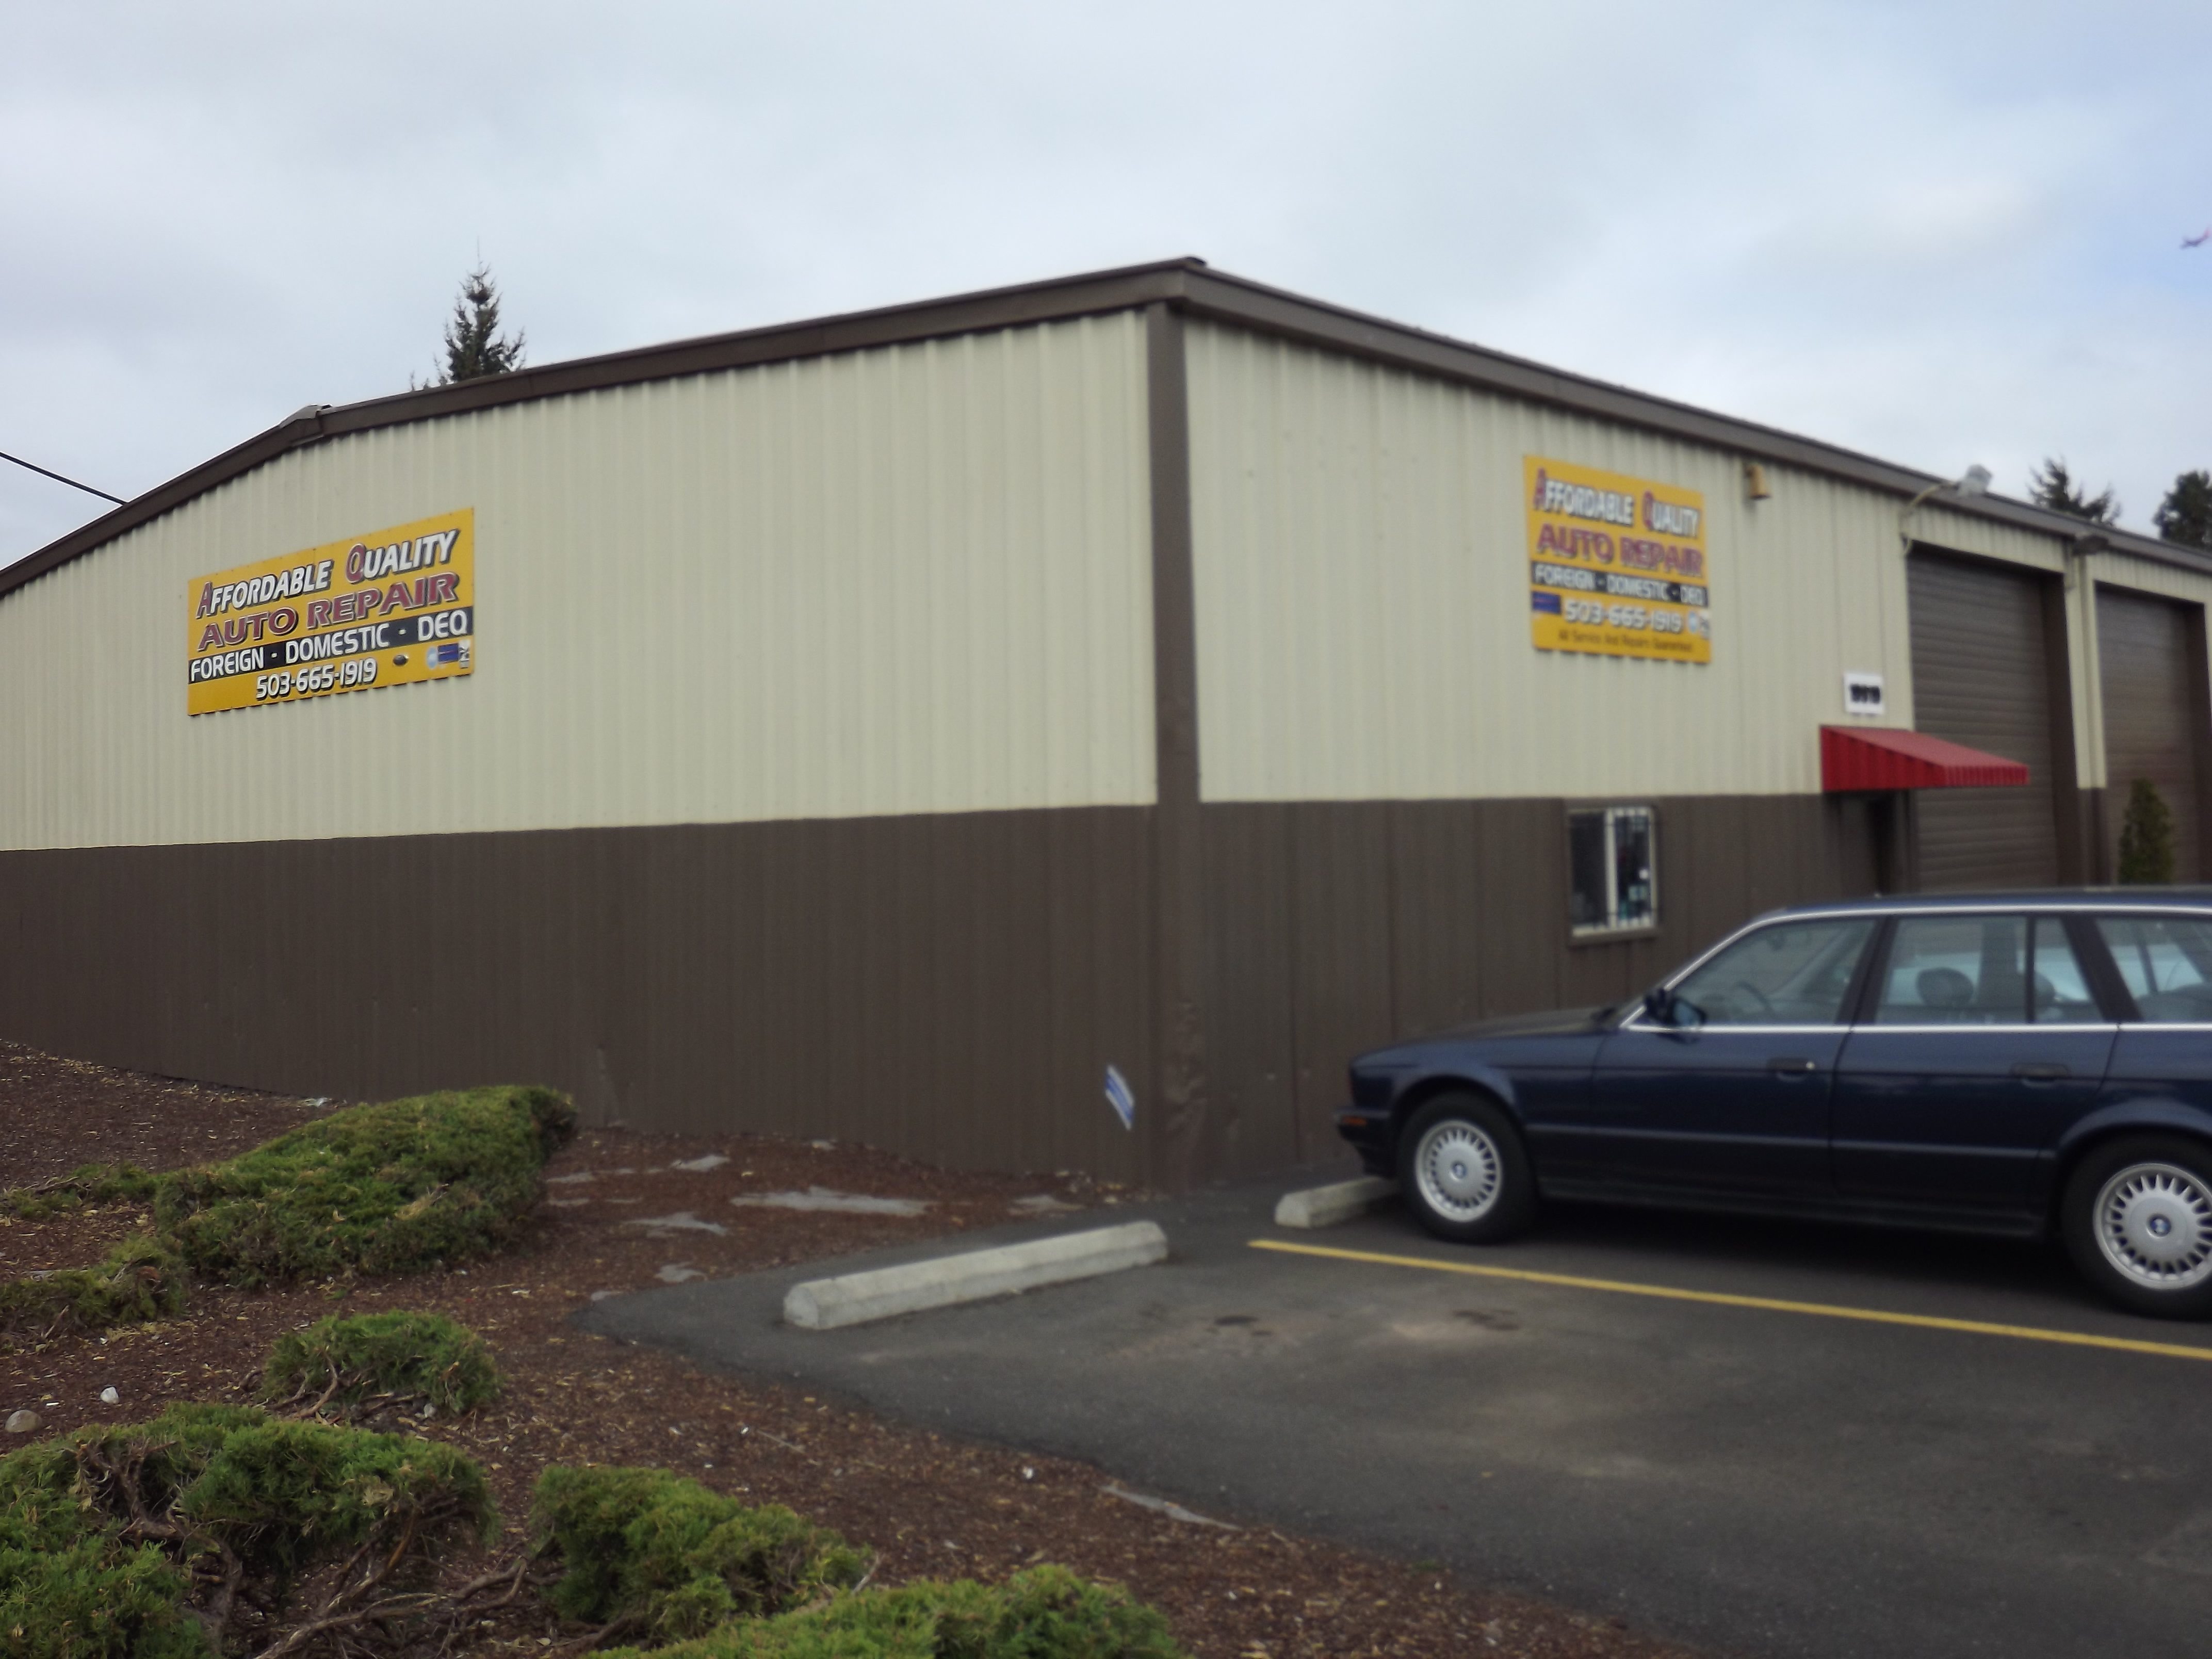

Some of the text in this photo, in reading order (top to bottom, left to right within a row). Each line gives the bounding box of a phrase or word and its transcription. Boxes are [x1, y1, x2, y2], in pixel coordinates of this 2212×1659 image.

[1533, 467, 1700, 539] AFFORDABLE QUALITY
[196, 528, 461, 619] AFFORDABLE QUALITY
[1535, 563, 1595, 591] FOREIGN
[1606, 573, 1668, 601] DOMESTIC
[1536, 523, 1702, 577] AUTO REPAIR
[190, 609, 467, 681] FOREIGN DOMESTIC DEQ
[197, 572, 460, 651] AUTO REPAIR
[256, 657, 378, 700] 503-665-1919
